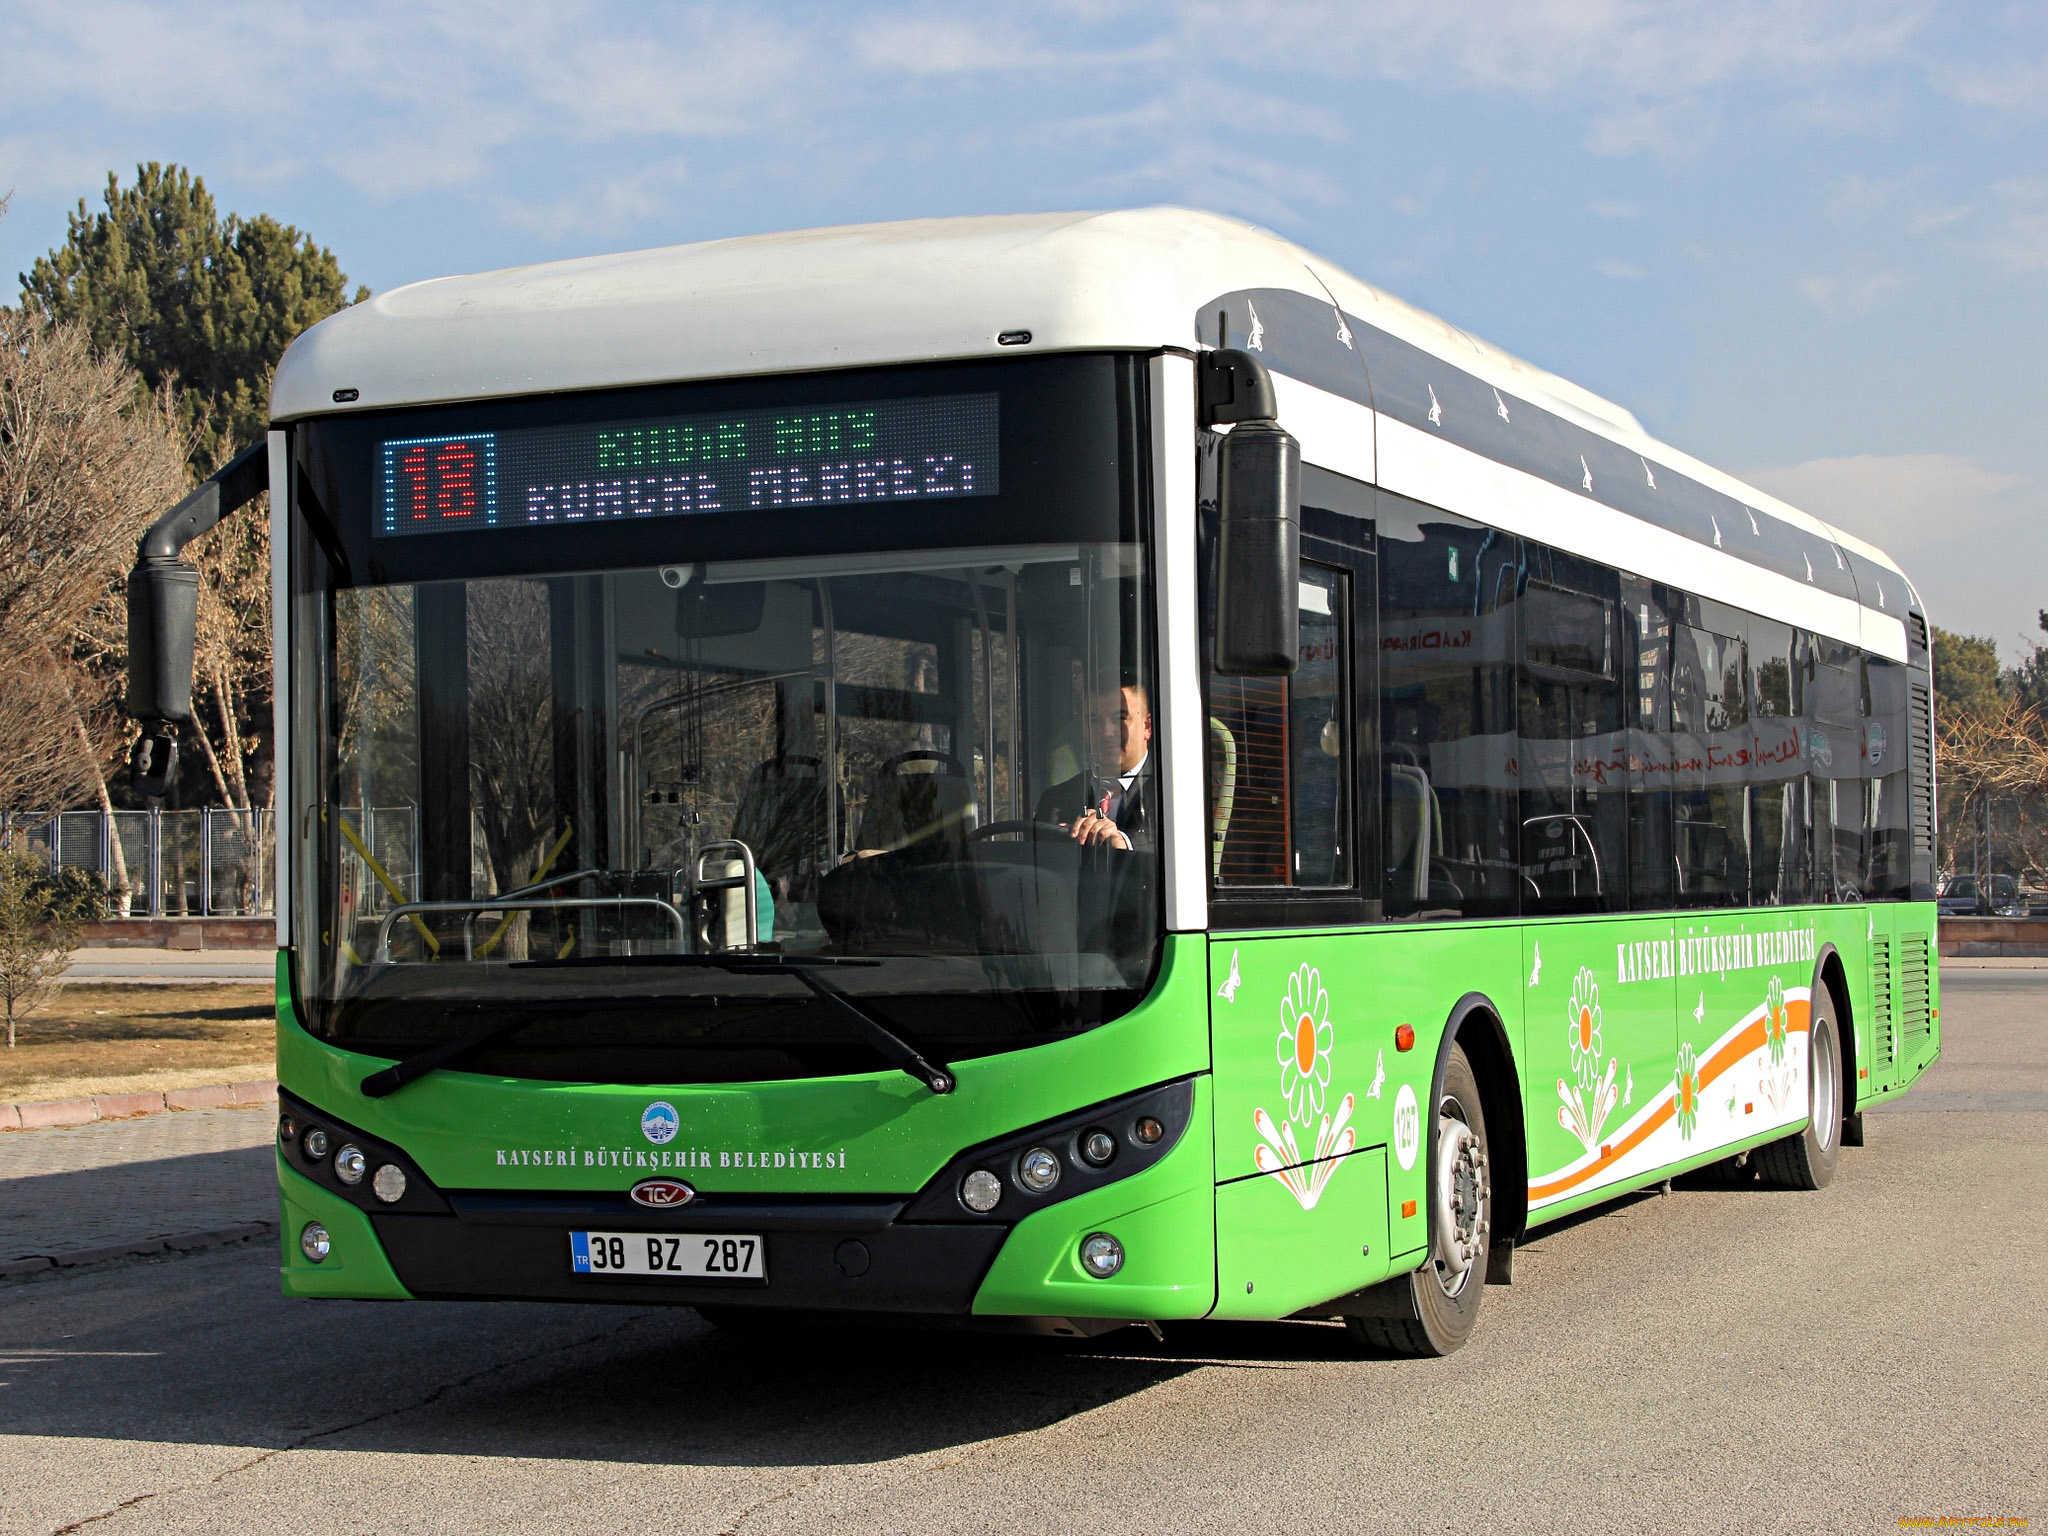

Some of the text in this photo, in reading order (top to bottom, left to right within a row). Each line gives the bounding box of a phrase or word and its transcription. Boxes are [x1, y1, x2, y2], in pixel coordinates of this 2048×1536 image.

[404, 445, 475, 519] 18
[1617, 918, 1815, 983] KAYSERİ BÜYÜKŞEHİR BELEDİYESİ
[1396, 1105, 1416, 1150] 1287
[496, 1147, 847, 1172] KAYSERİ BÜYÜKŞEHİR BELEDİYESİ
[576, 1254, 589, 1265] TR
[591, 1236, 755, 1273] 38 BZ 287
